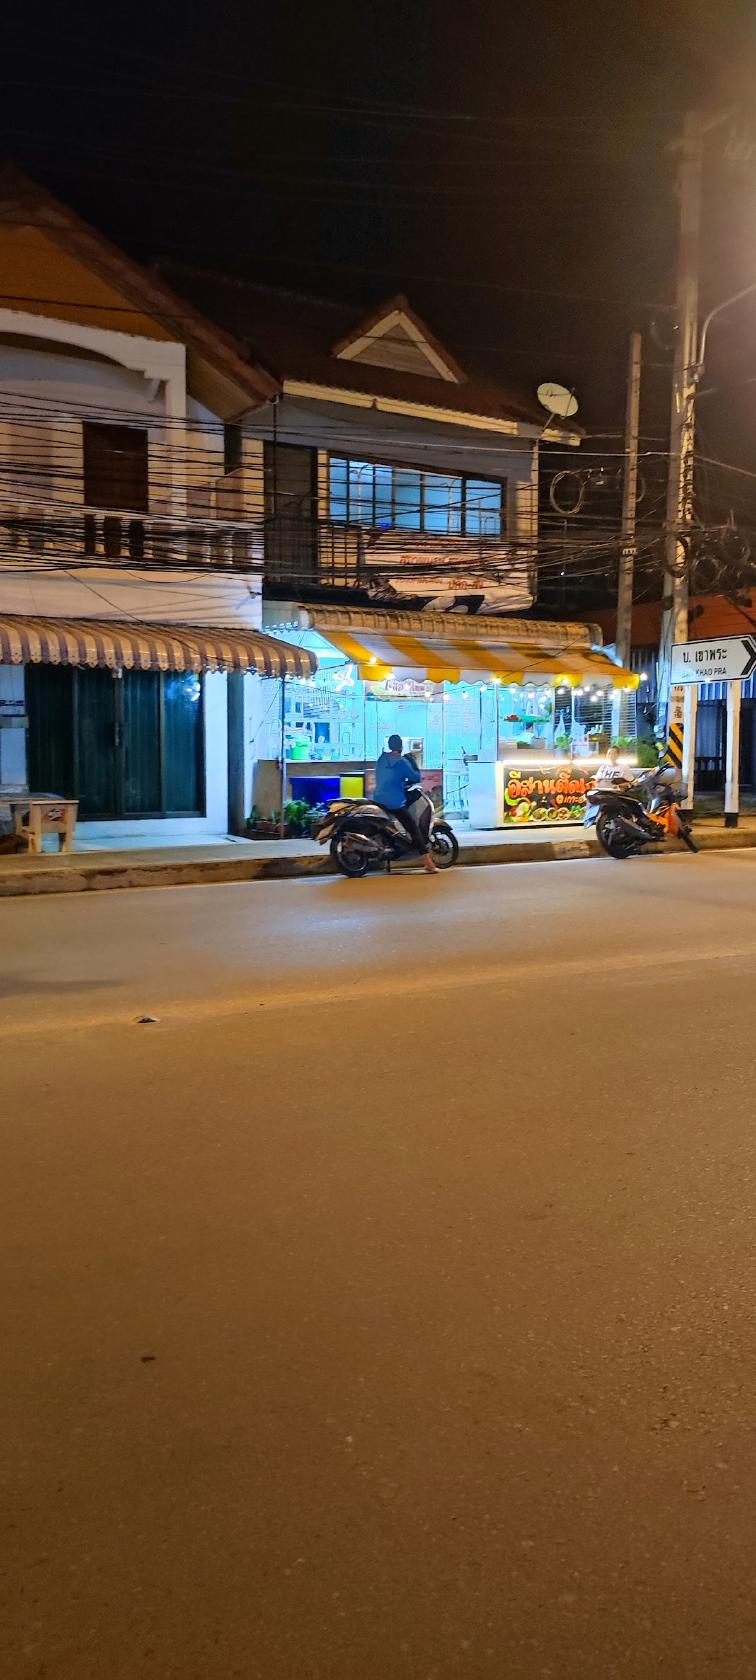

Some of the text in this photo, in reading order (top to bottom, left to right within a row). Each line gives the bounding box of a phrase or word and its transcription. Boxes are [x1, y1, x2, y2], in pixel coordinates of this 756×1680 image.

[695, 648, 728, 662] เขาพระ
[695, 668, 713, 676] KHAO
[713, 667, 727, 675] PRA
